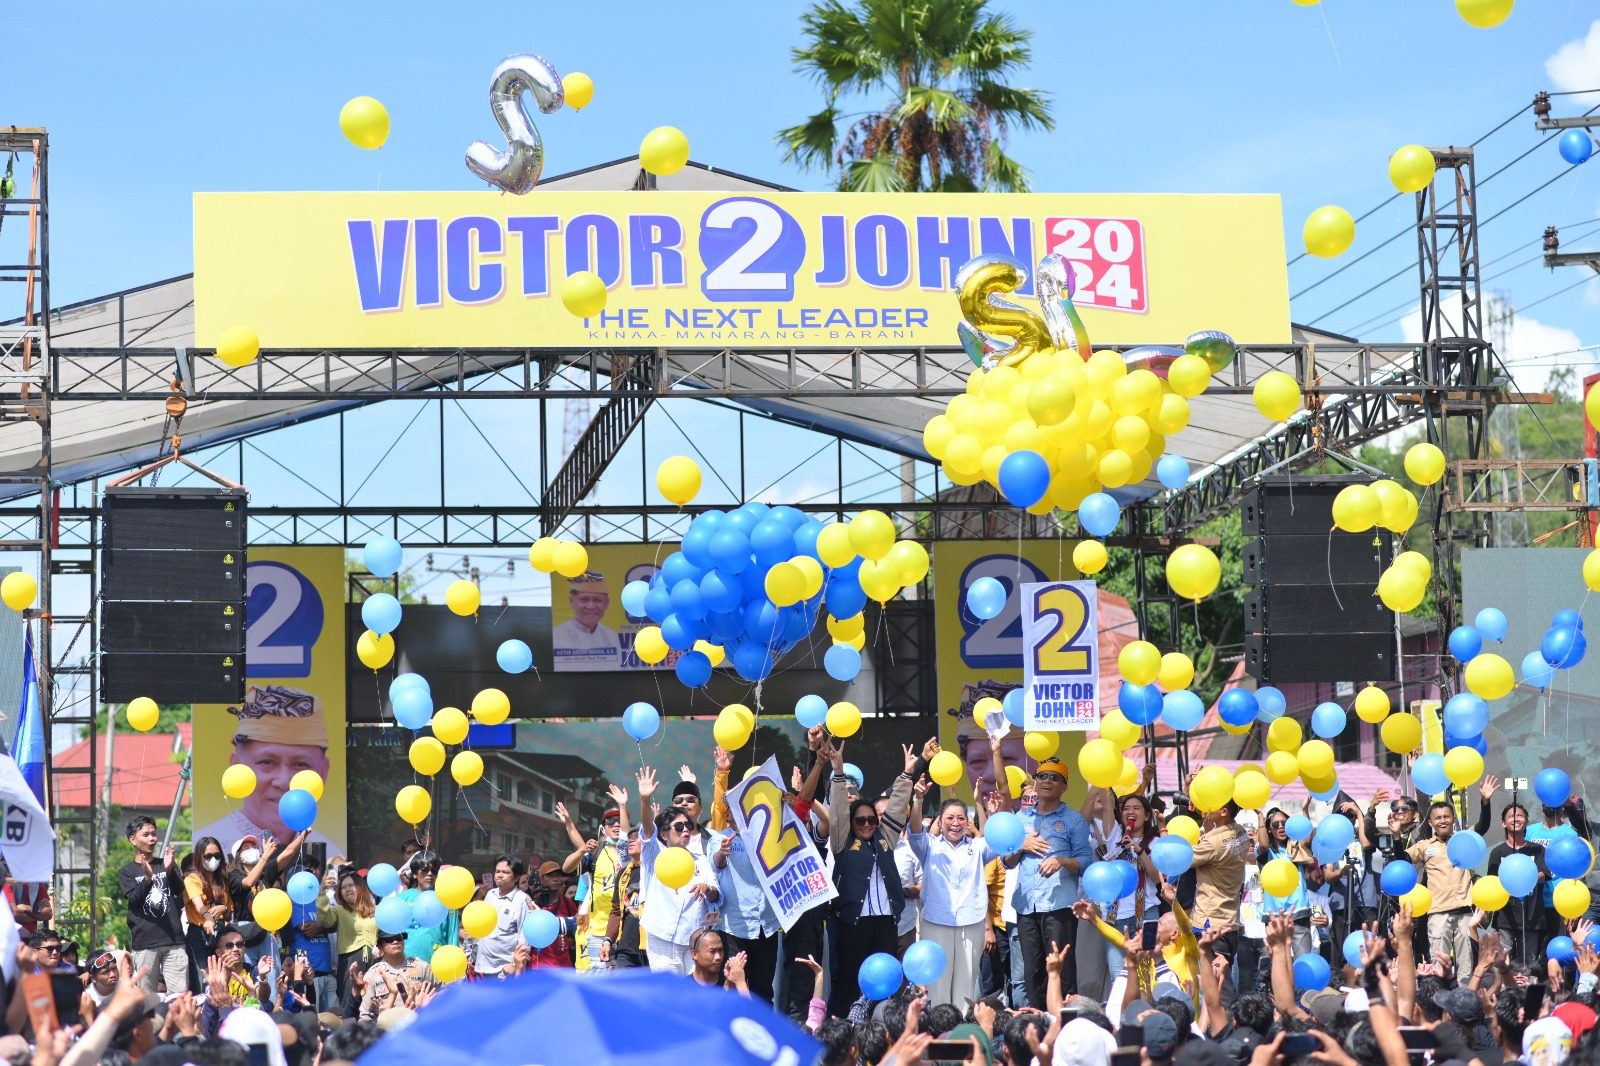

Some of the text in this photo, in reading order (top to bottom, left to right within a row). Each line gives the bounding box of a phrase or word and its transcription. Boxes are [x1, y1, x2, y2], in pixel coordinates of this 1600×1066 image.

[347, 199, 1034, 314] VICTOR 2 JOHN
[1051, 219, 1135, 262] 20
[664, 308, 762, 329] NEXT
[777, 307, 929, 329] LEADER
[829, 329, 915, 339] BARANI
[246, 560, 305, 666] 2
[1033, 583, 1092, 676] 2
[1033, 683, 1094, 701] VICTOR
[1034, 701, 1075, 718] JOHN
[738, 775, 808, 878] 2
[769, 855, 820, 899] VICTOR
[808, 873, 821, 885] 20
[811, 882, 825, 893] 24
[778, 878, 811, 915] JOHN
